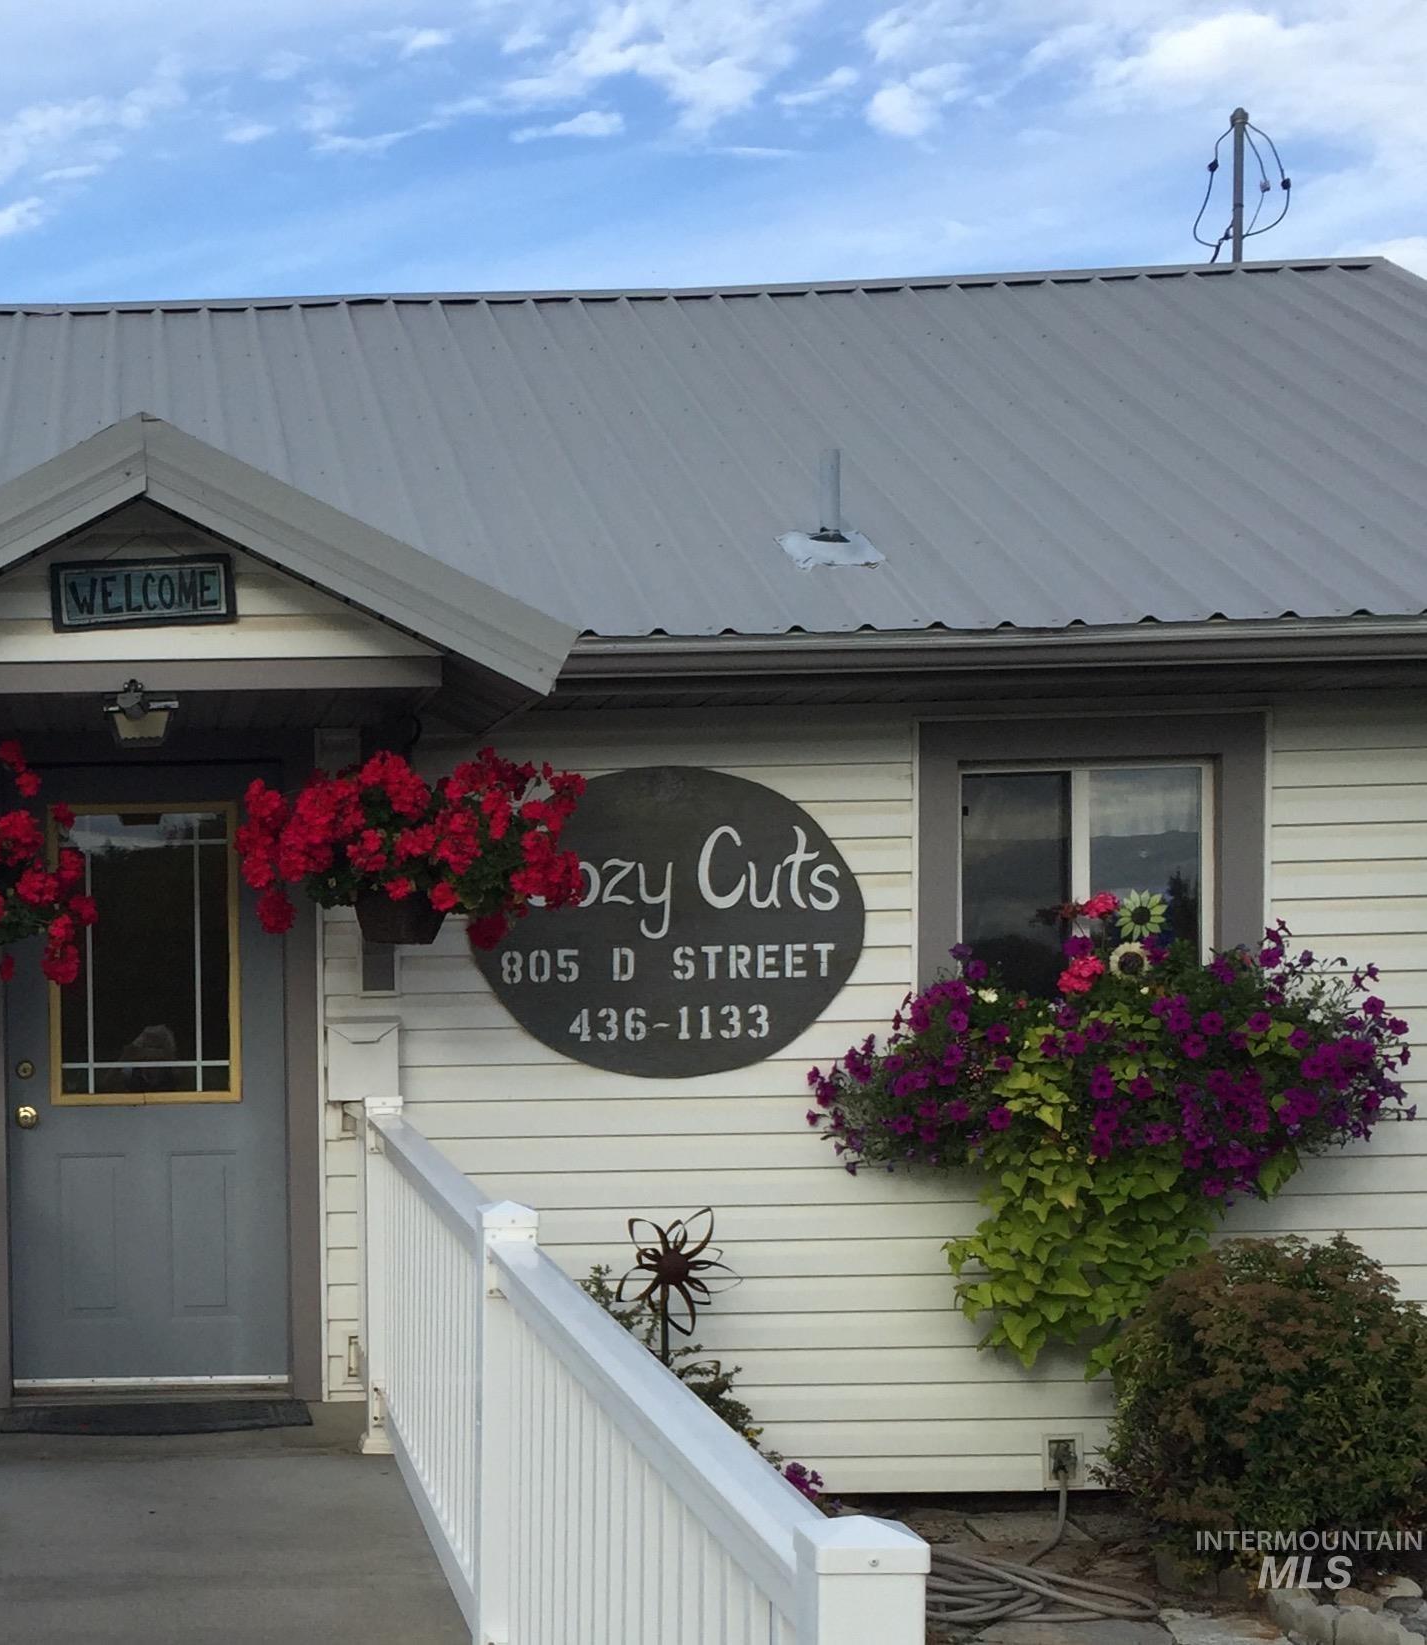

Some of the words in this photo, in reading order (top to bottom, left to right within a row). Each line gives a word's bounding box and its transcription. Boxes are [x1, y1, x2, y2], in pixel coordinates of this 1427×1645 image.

[69, 570, 218, 616] WELCOME
[698, 825, 840, 911] Cuts
[501, 949, 580, 984] 805
[612, 947, 635, 982] D
[673, 943, 835, 981] STREET
[569, 1004, 770, 1042] 436-1133
